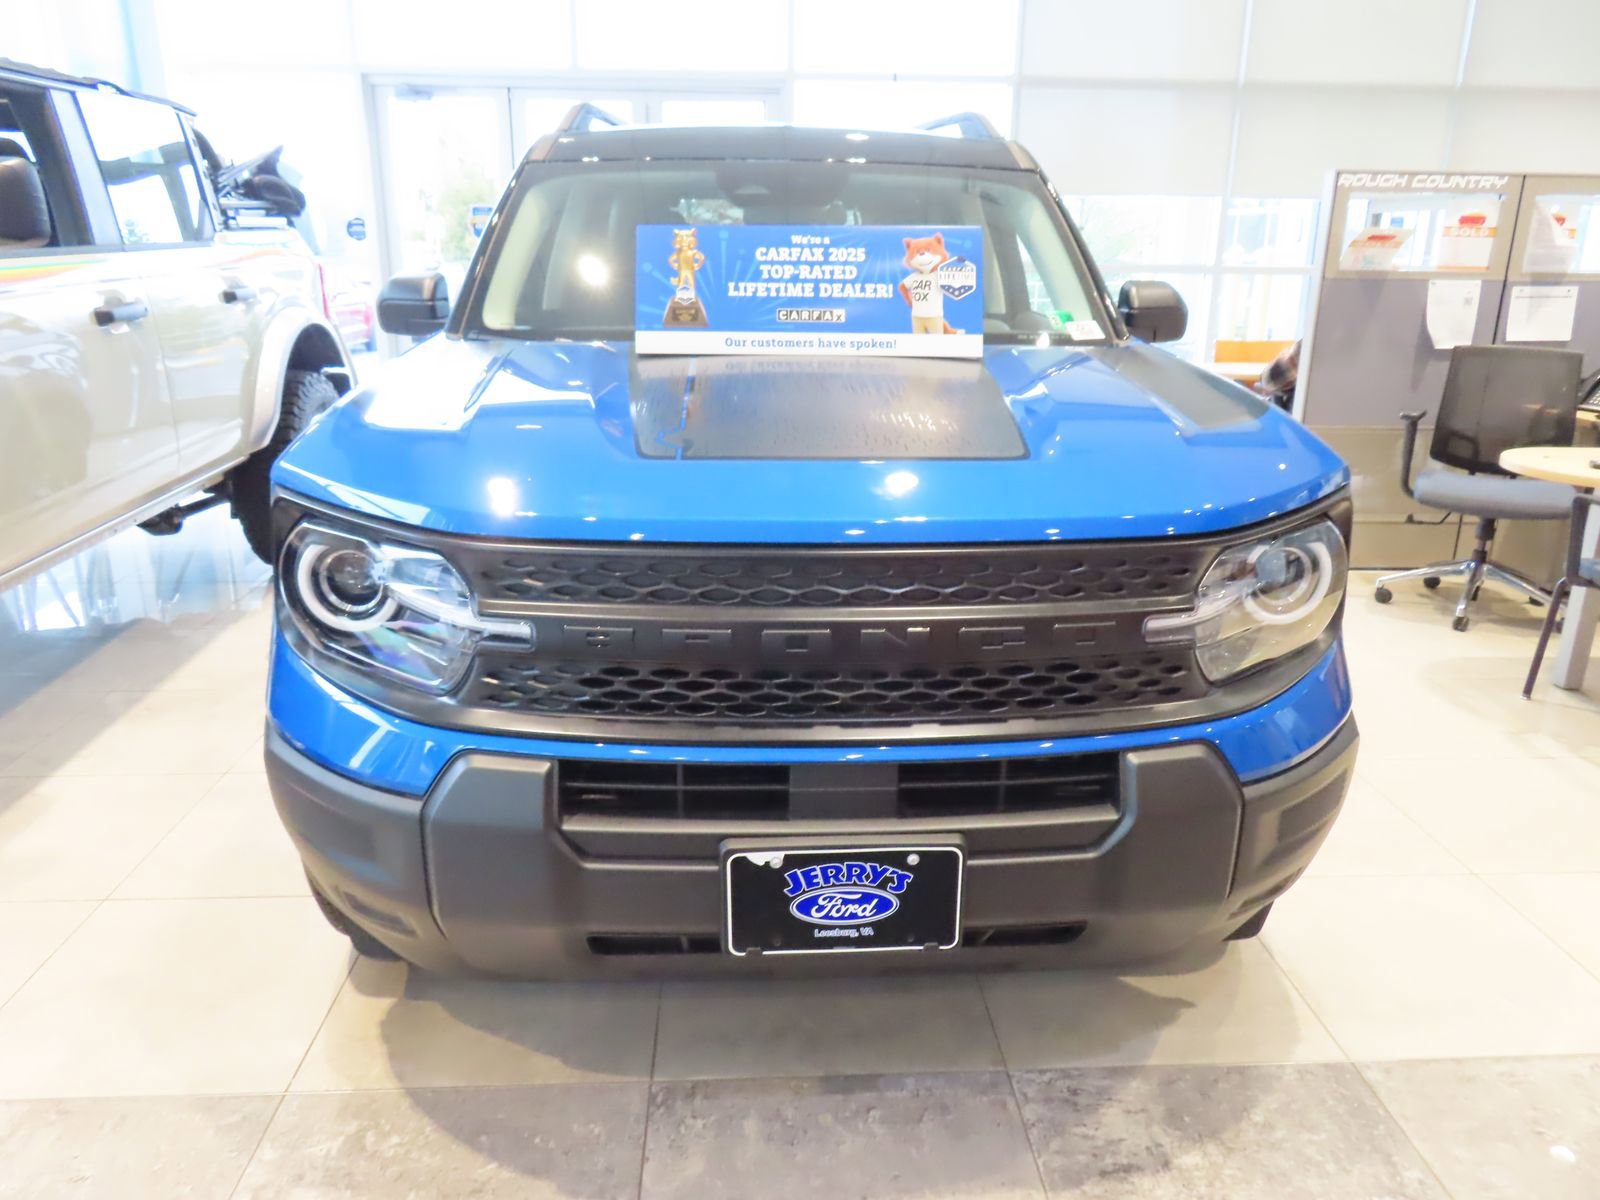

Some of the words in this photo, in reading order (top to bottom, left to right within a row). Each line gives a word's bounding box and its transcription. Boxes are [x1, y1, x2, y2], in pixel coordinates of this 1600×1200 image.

[1338, 173, 1407, 187] ROUGH
[1411, 174, 1508, 189] COUNTRY
[755, 247, 825, 262] CARFAX
[828, 247, 866, 262] 2025
[759, 265, 858, 281] TOP-RATED
[727, 283, 816, 298] LIFETIME
[818, 282, 893, 299] DEALER!
[777, 309, 846, 322] CARFAX
[725, 337, 748, 348] Our
[751, 338, 815, 349] customers
[818, 338, 847, 349] have
[850, 338, 897, 351] spoken!
[784, 862, 913, 896] JERRY'S
[811, 894, 879, 919] Ford
